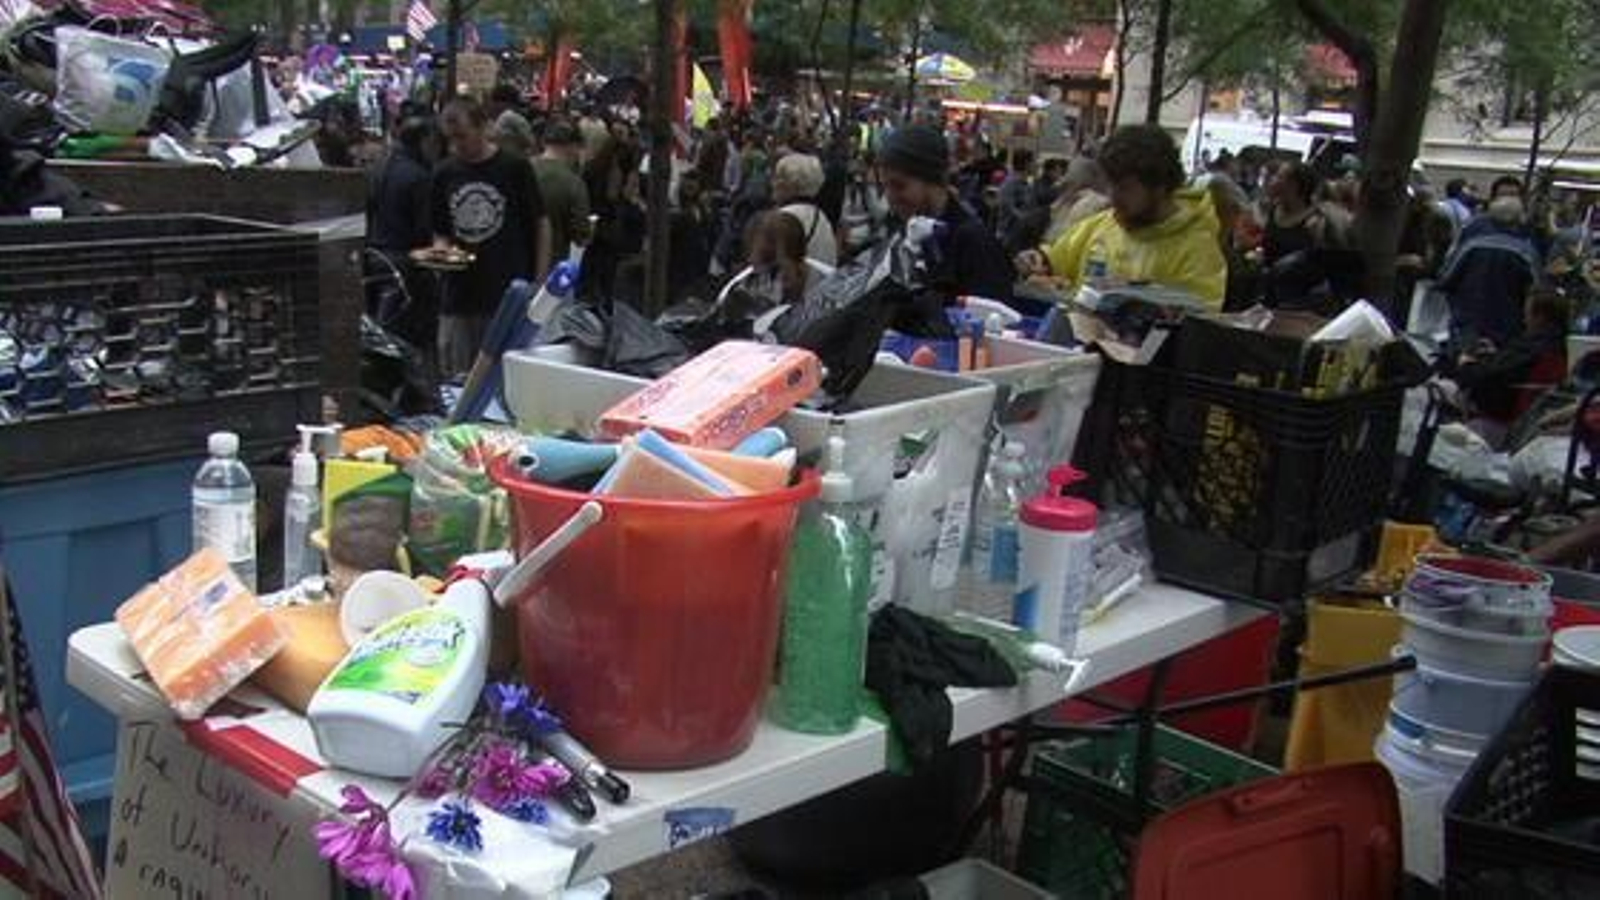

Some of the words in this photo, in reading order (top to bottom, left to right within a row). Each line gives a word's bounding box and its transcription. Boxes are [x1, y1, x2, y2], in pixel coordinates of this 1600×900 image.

[121, 784, 147, 827] of
[128, 721, 173, 780] The
[196, 754, 289, 862] Luxury
